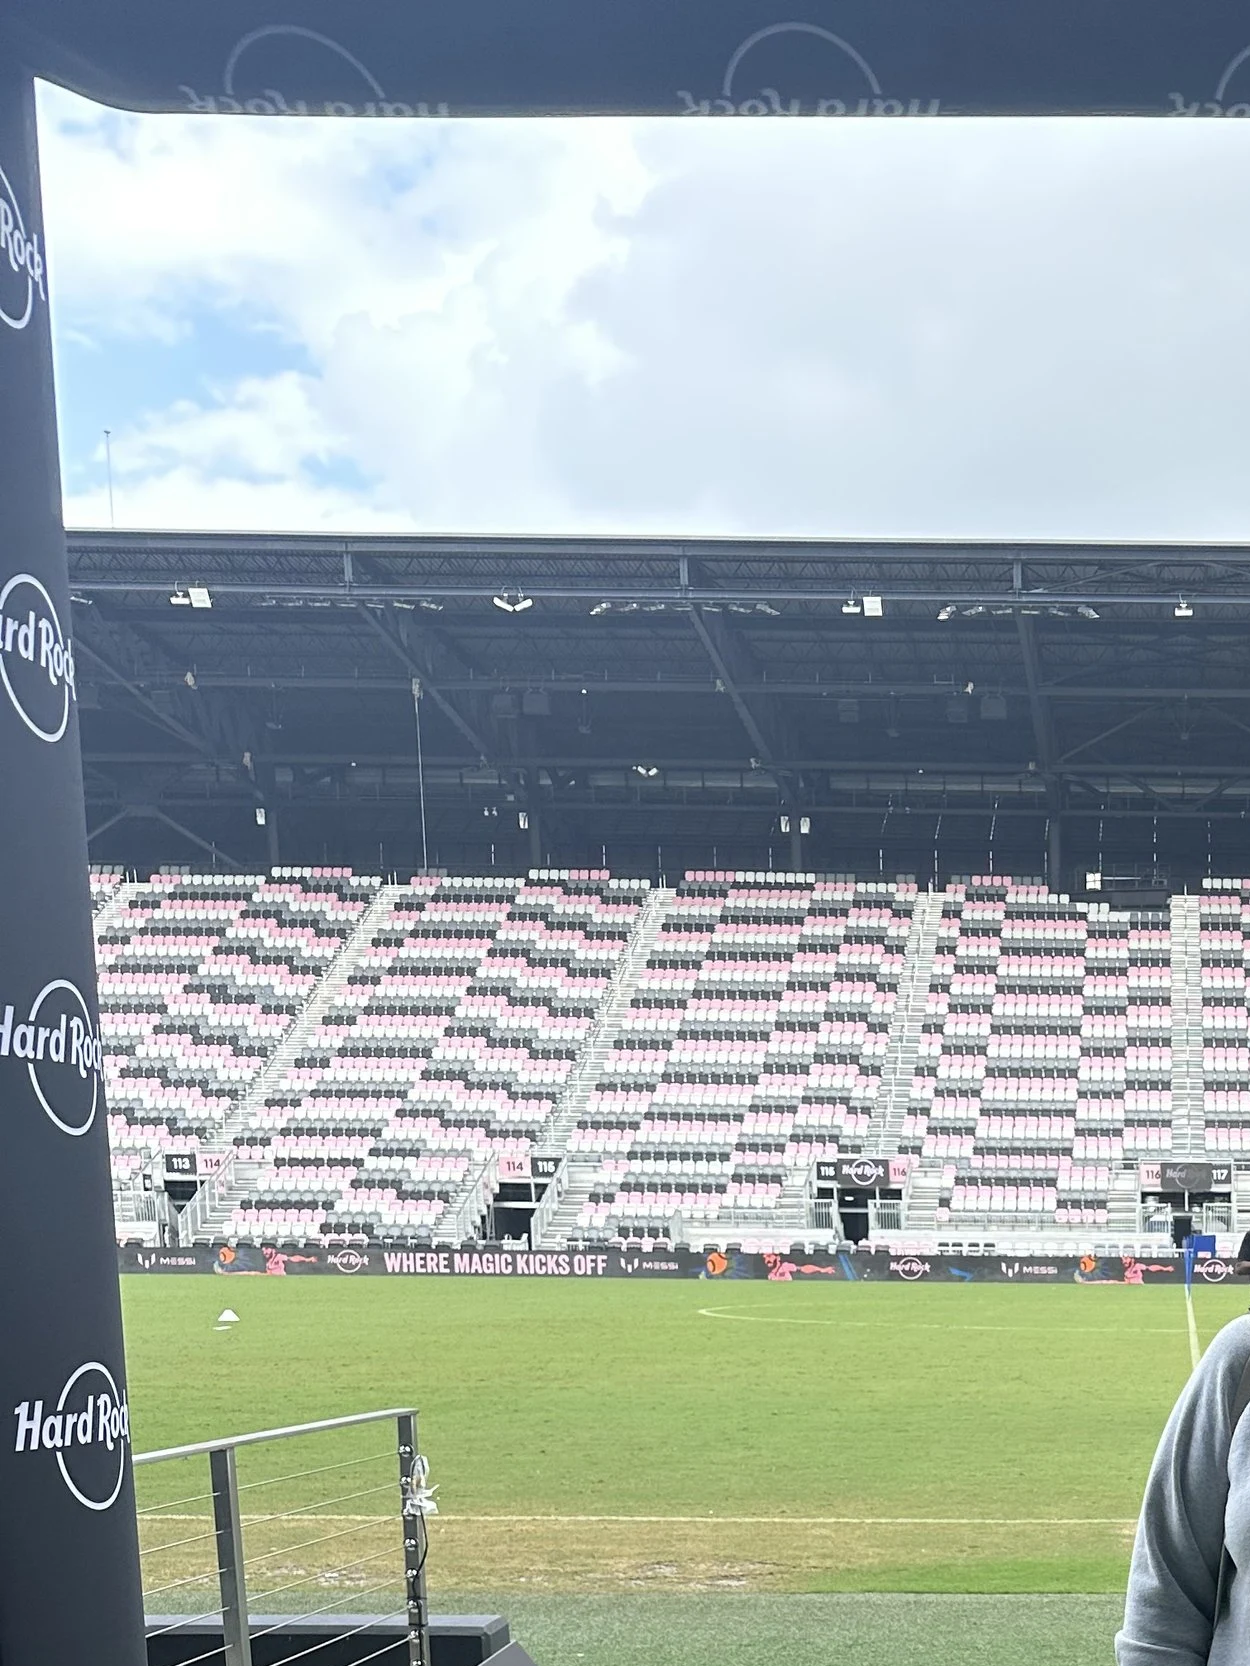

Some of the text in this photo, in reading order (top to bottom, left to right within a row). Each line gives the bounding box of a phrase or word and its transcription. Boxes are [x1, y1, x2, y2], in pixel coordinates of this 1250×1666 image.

[0, 610, 77, 702] rd Rock
[70, 1014, 105, 1082] Rock
[172, 1157, 221, 1170] 113 114
[506, 1161, 524, 1172] 114
[841, 1164, 885, 1178] Hard Rock
[893, 1167, 907, 1177] 116
[1146, 1169, 1161, 1179] 116
[1165, 1168, 1187, 1178] Hard
[1211, 1169, 1229, 1180] 117
[159, 1256, 196, 1266] MESSI
[327, 1254, 369, 1266] Hard Rock
[383, 1252, 608, 1276] WHERE MAGIC KICKS OFF
[642, 1261, 679, 1271] MESSI
[889, 1262, 931, 1274] Hard Rock
[1022, 1265, 1058, 1275] MESSI
[1193, 1264, 1234, 1275] Hard Rock
[13, 1388, 131, 1452] Hard Rock
